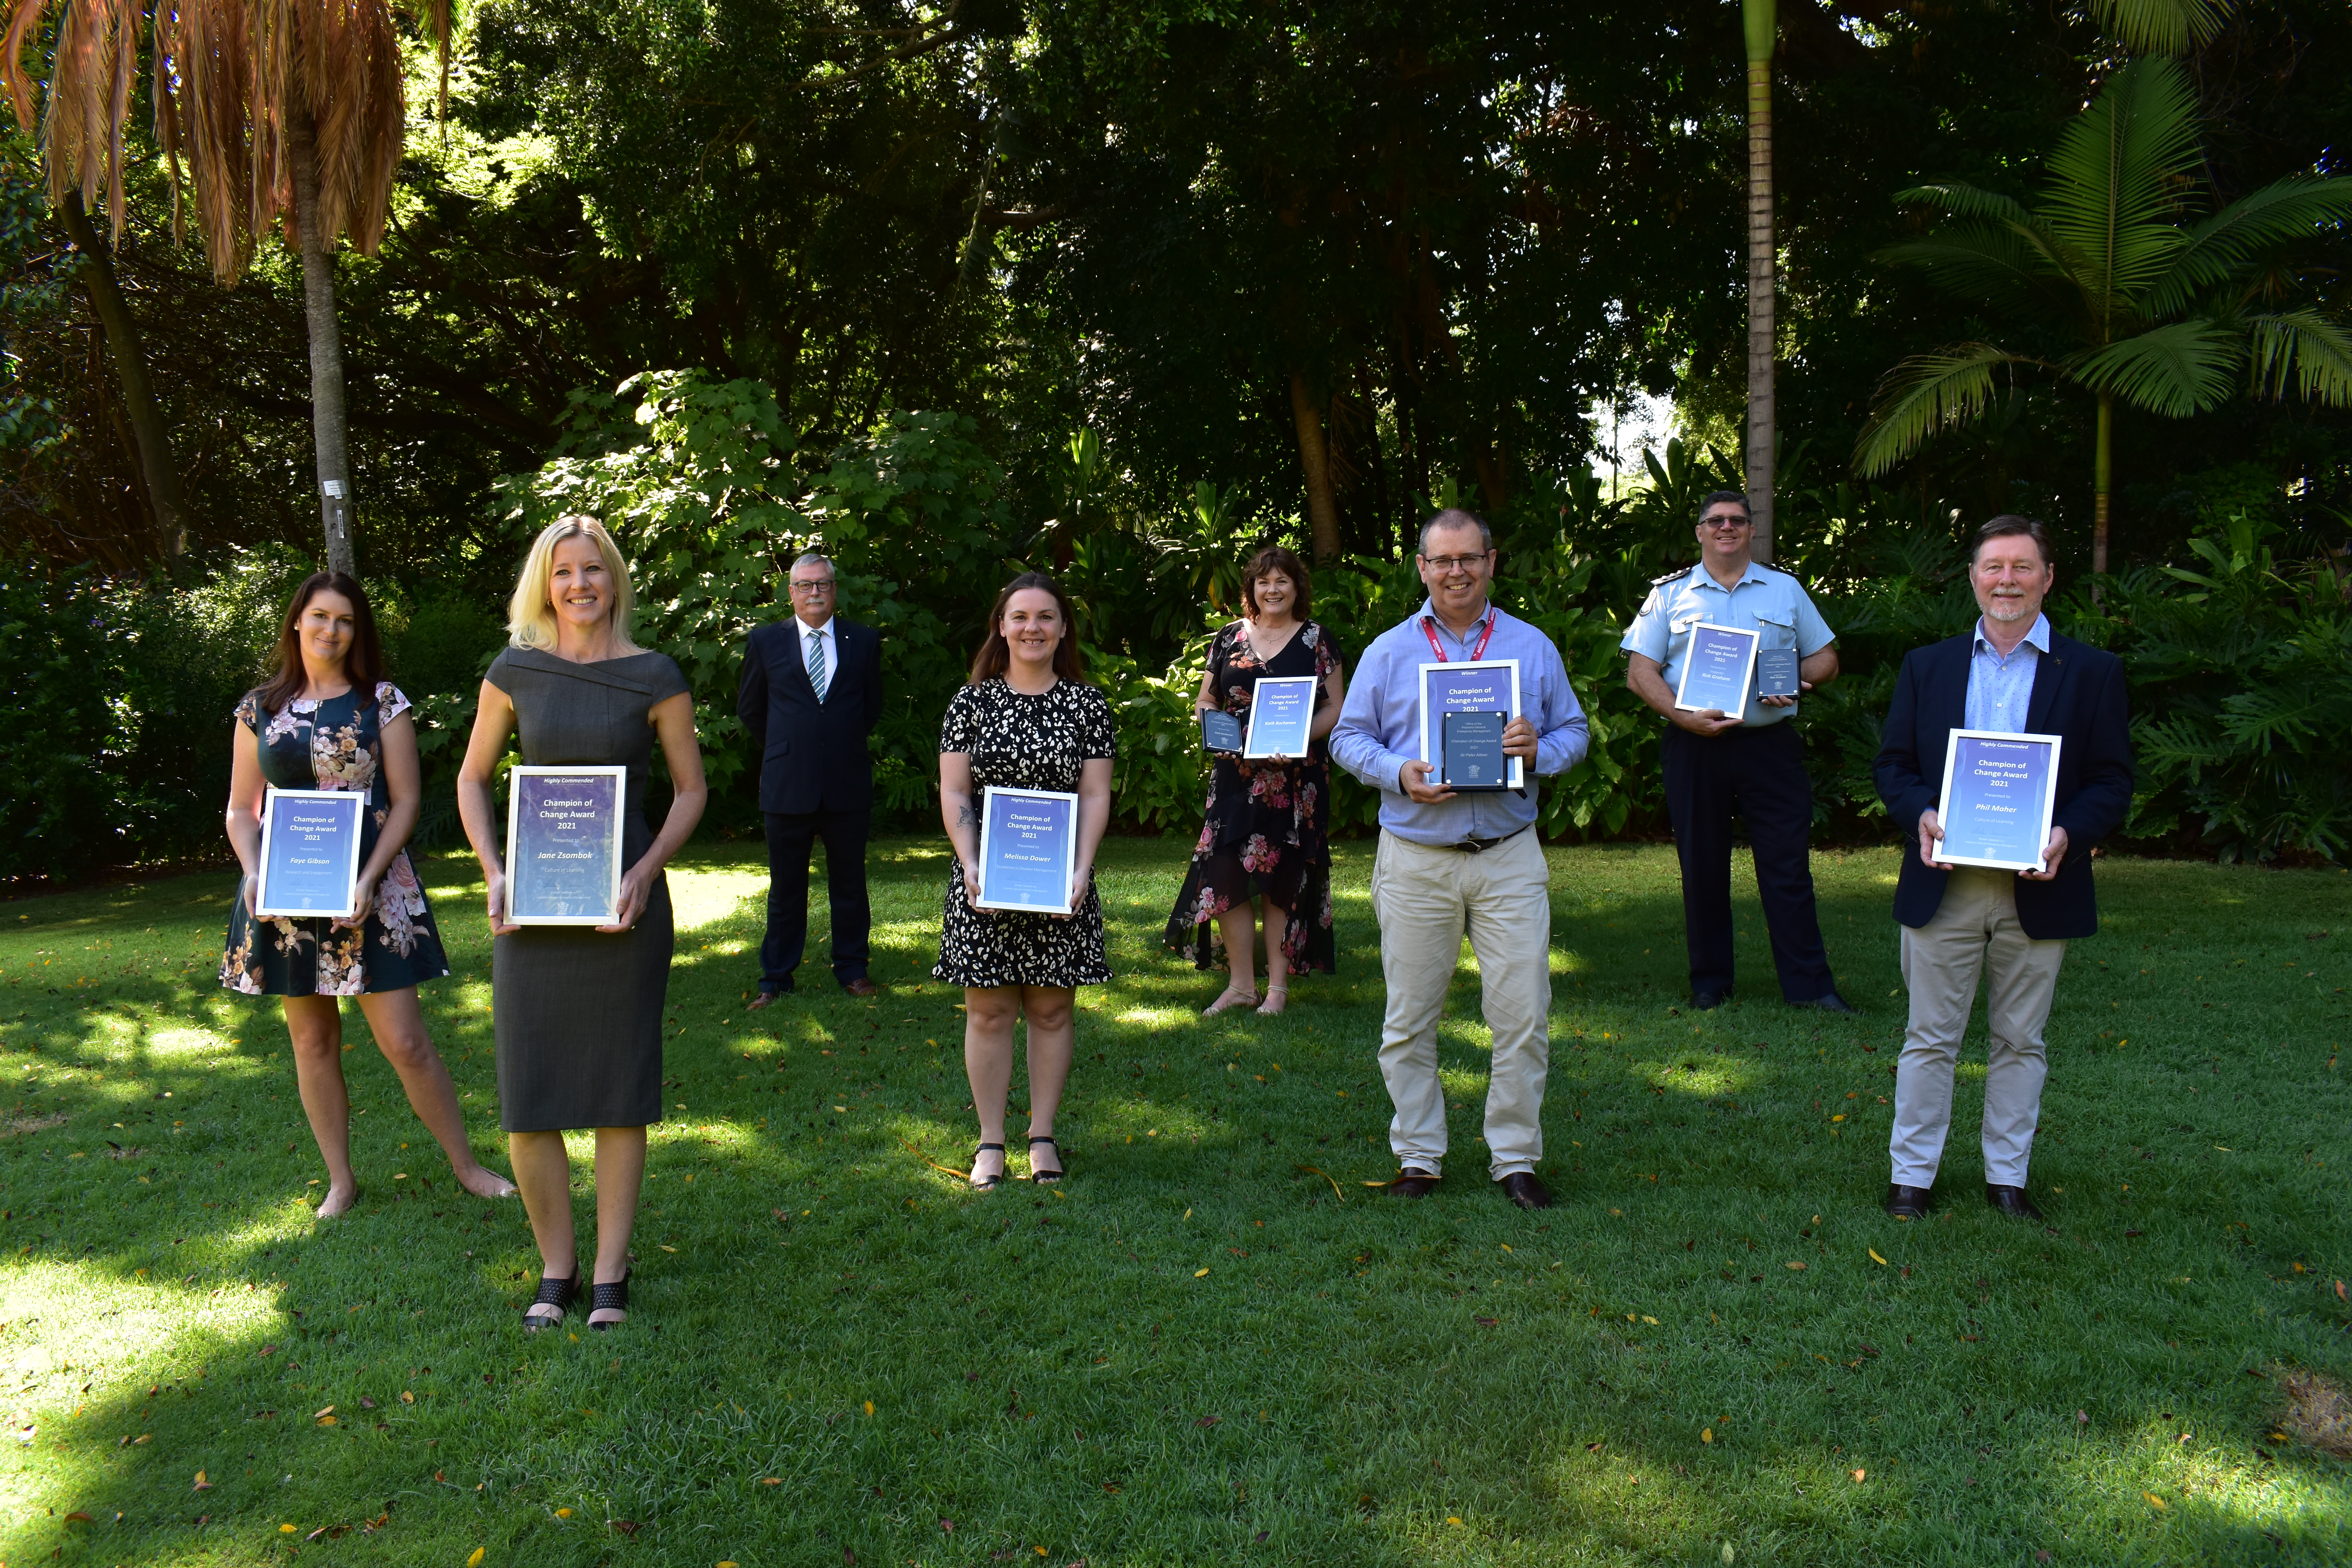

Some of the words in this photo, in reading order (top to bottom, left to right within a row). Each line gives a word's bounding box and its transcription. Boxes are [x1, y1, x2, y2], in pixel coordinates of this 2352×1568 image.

[1978, 760, 2016, 769] Champion
[1974, 769, 2001, 778] Change
[540, 811, 568, 819] Change
[1011, 814, 1042, 822] Champion
